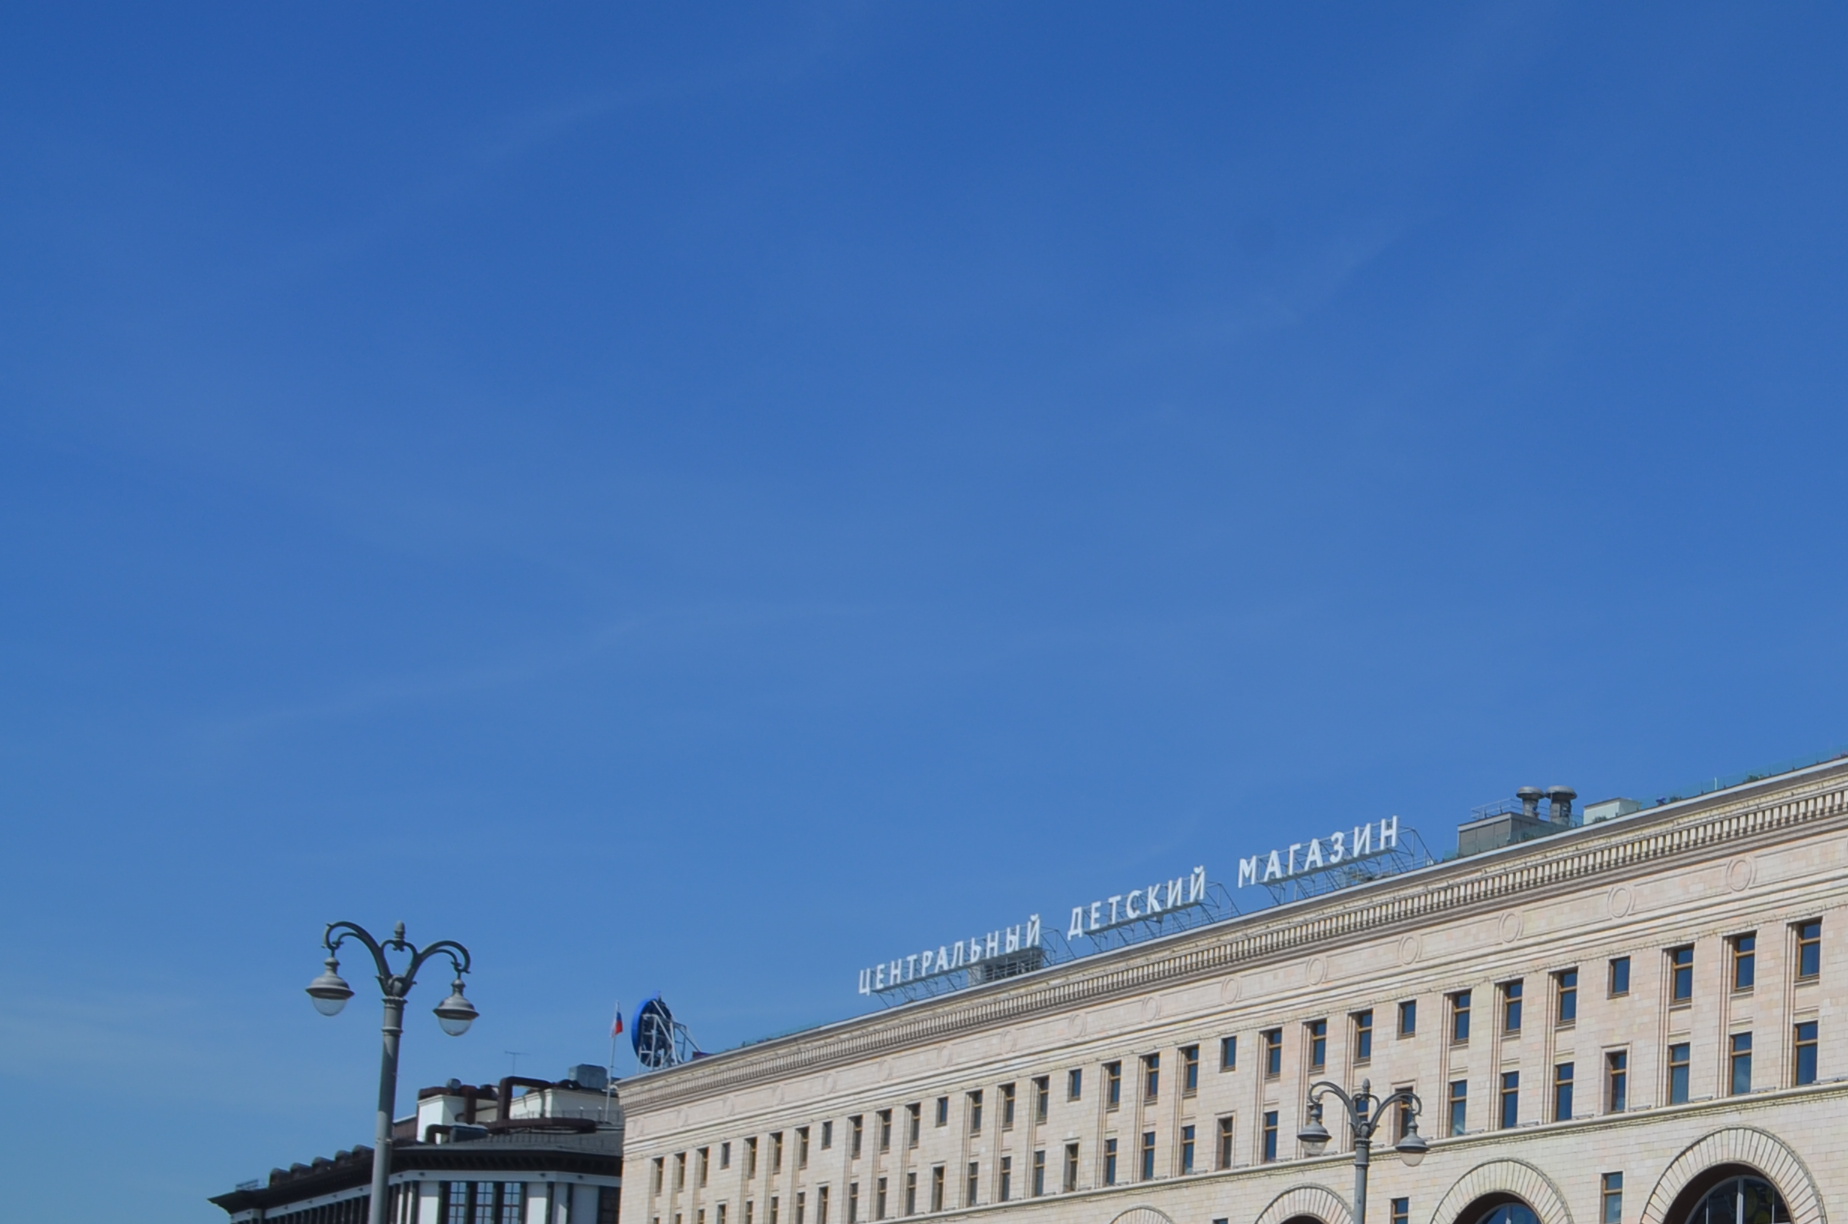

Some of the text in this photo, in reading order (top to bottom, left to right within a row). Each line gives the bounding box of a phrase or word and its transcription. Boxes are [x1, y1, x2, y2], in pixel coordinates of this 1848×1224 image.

[858, 815, 1399, 996] ЦЕНТРАЛЬНЫЙ ДЕТСКИЙ МАГАЗИН
